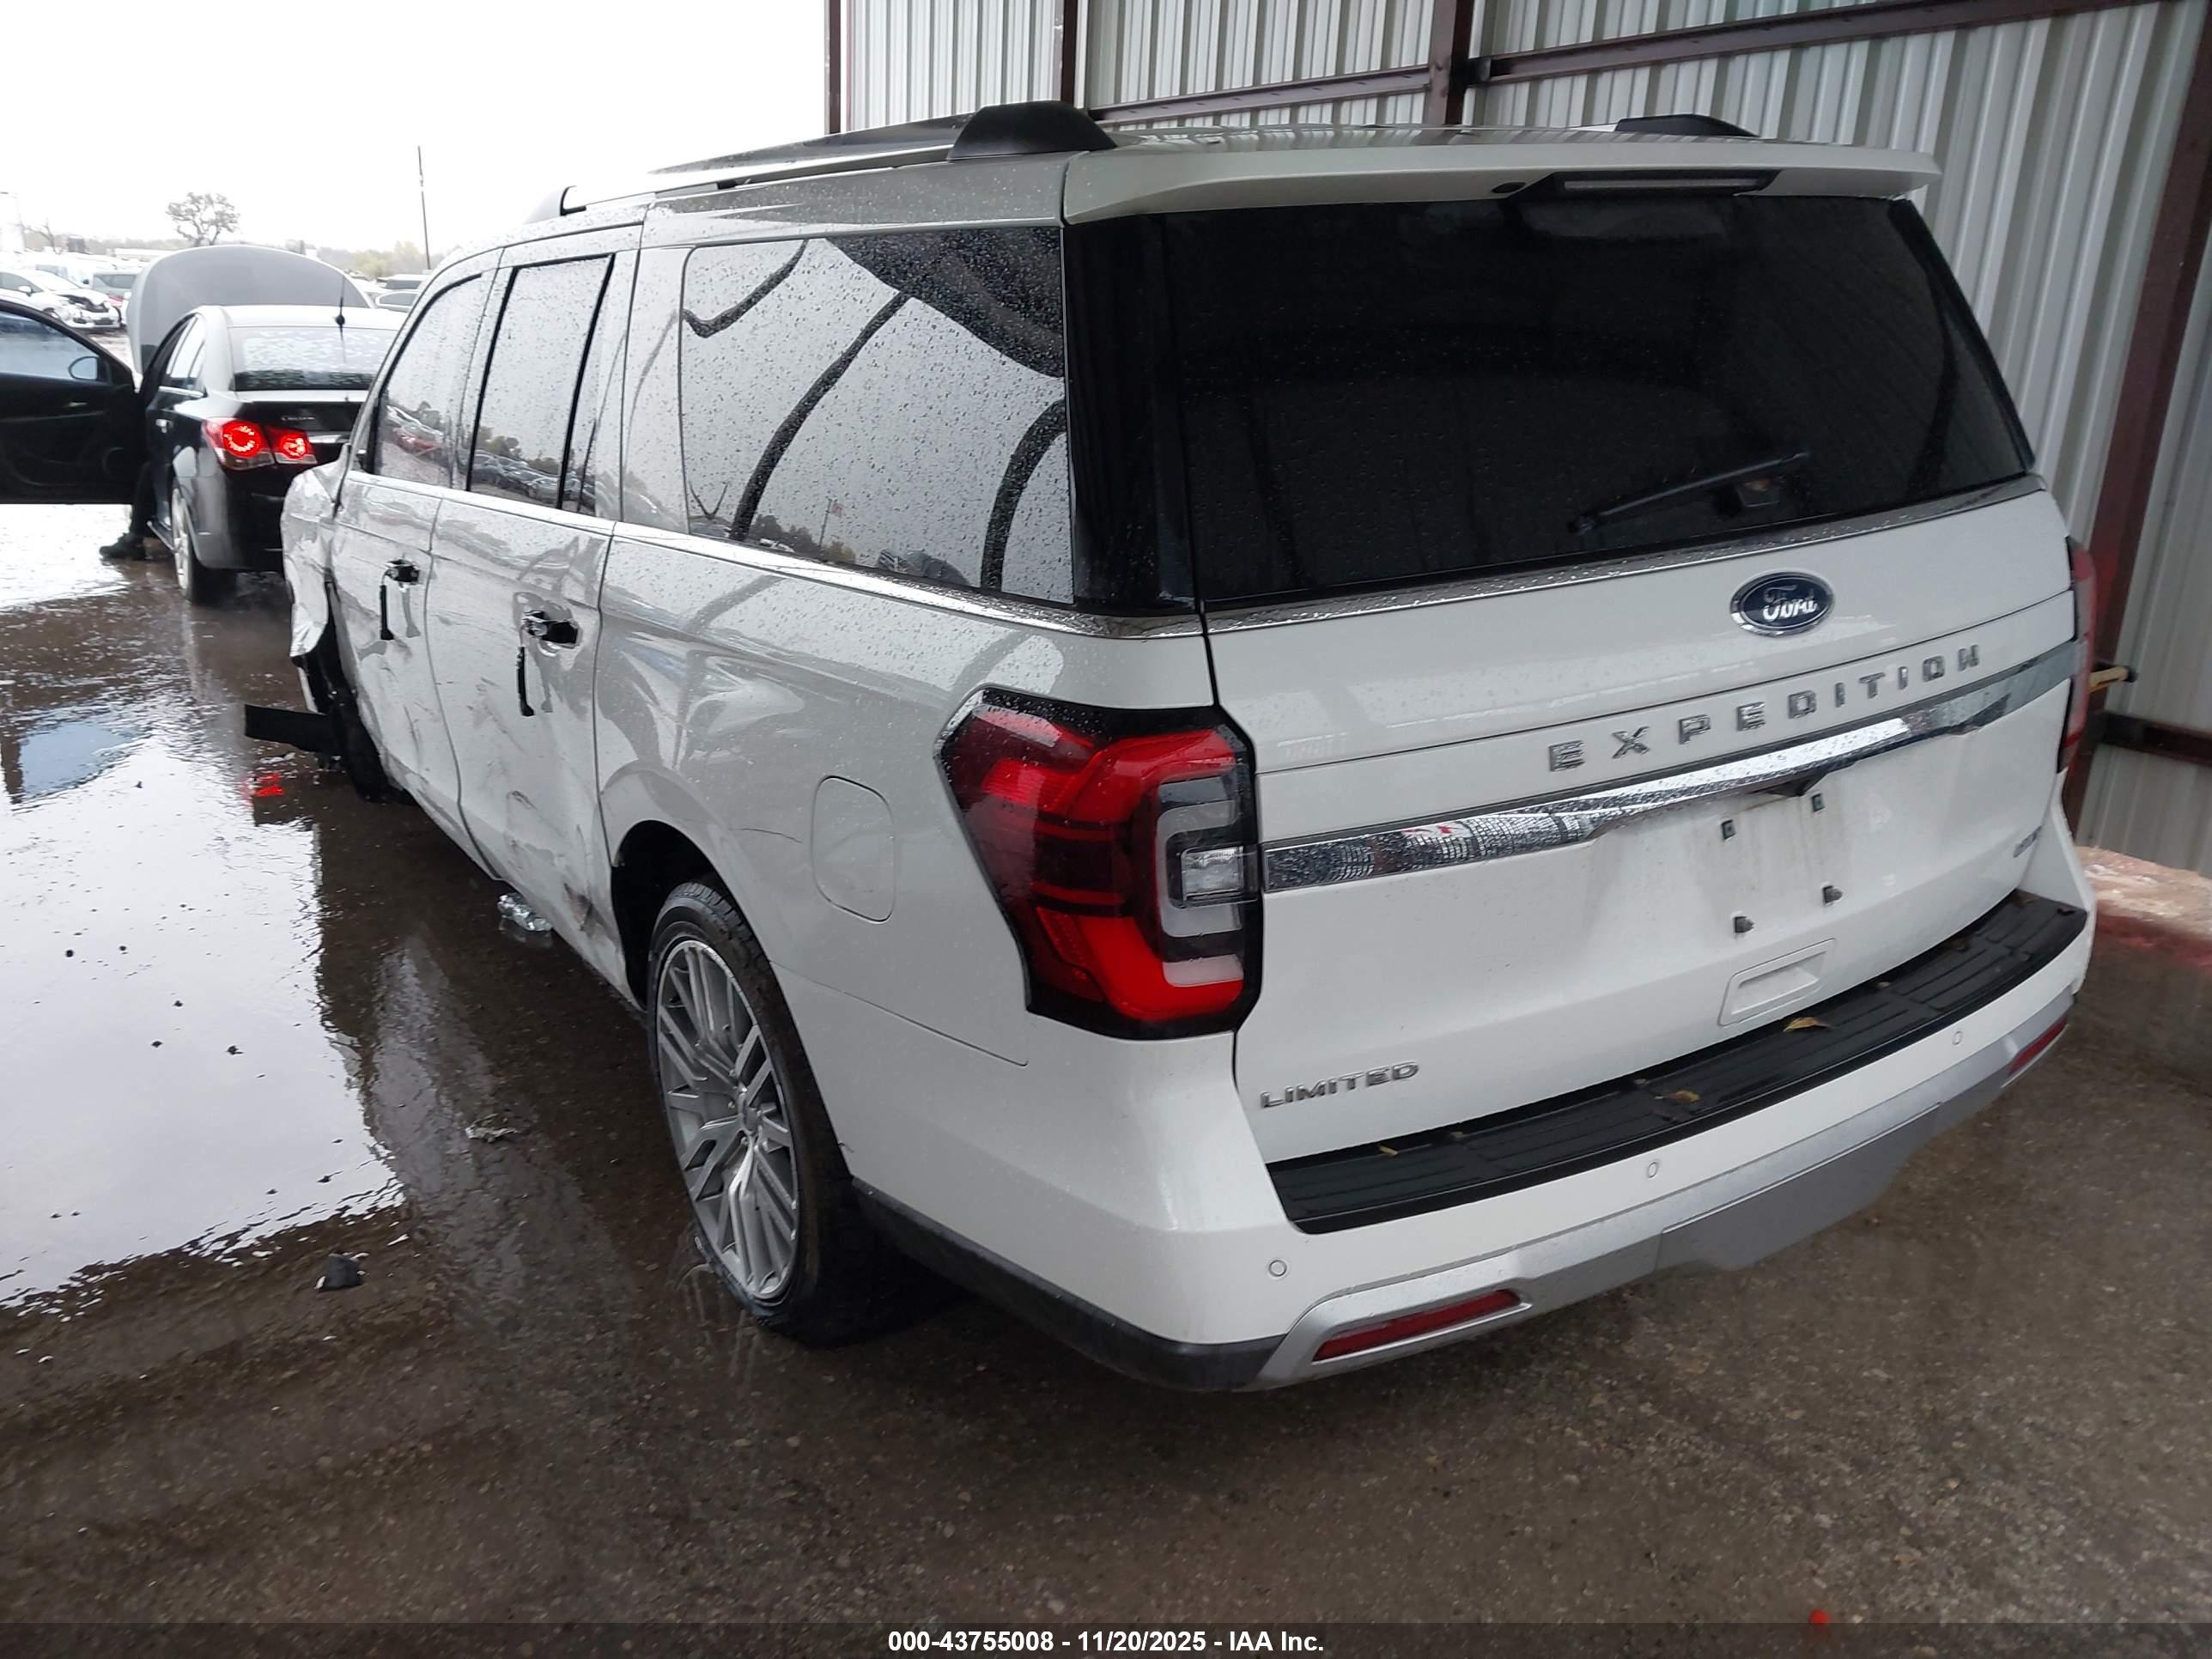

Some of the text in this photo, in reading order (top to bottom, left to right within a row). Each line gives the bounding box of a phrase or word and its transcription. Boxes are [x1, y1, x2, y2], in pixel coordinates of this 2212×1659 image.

[1762, 584, 1819, 622] Ford
[1548, 644, 1980, 772] EXPEDITION
[1260, 1060, 1419, 1108] LIMITED
